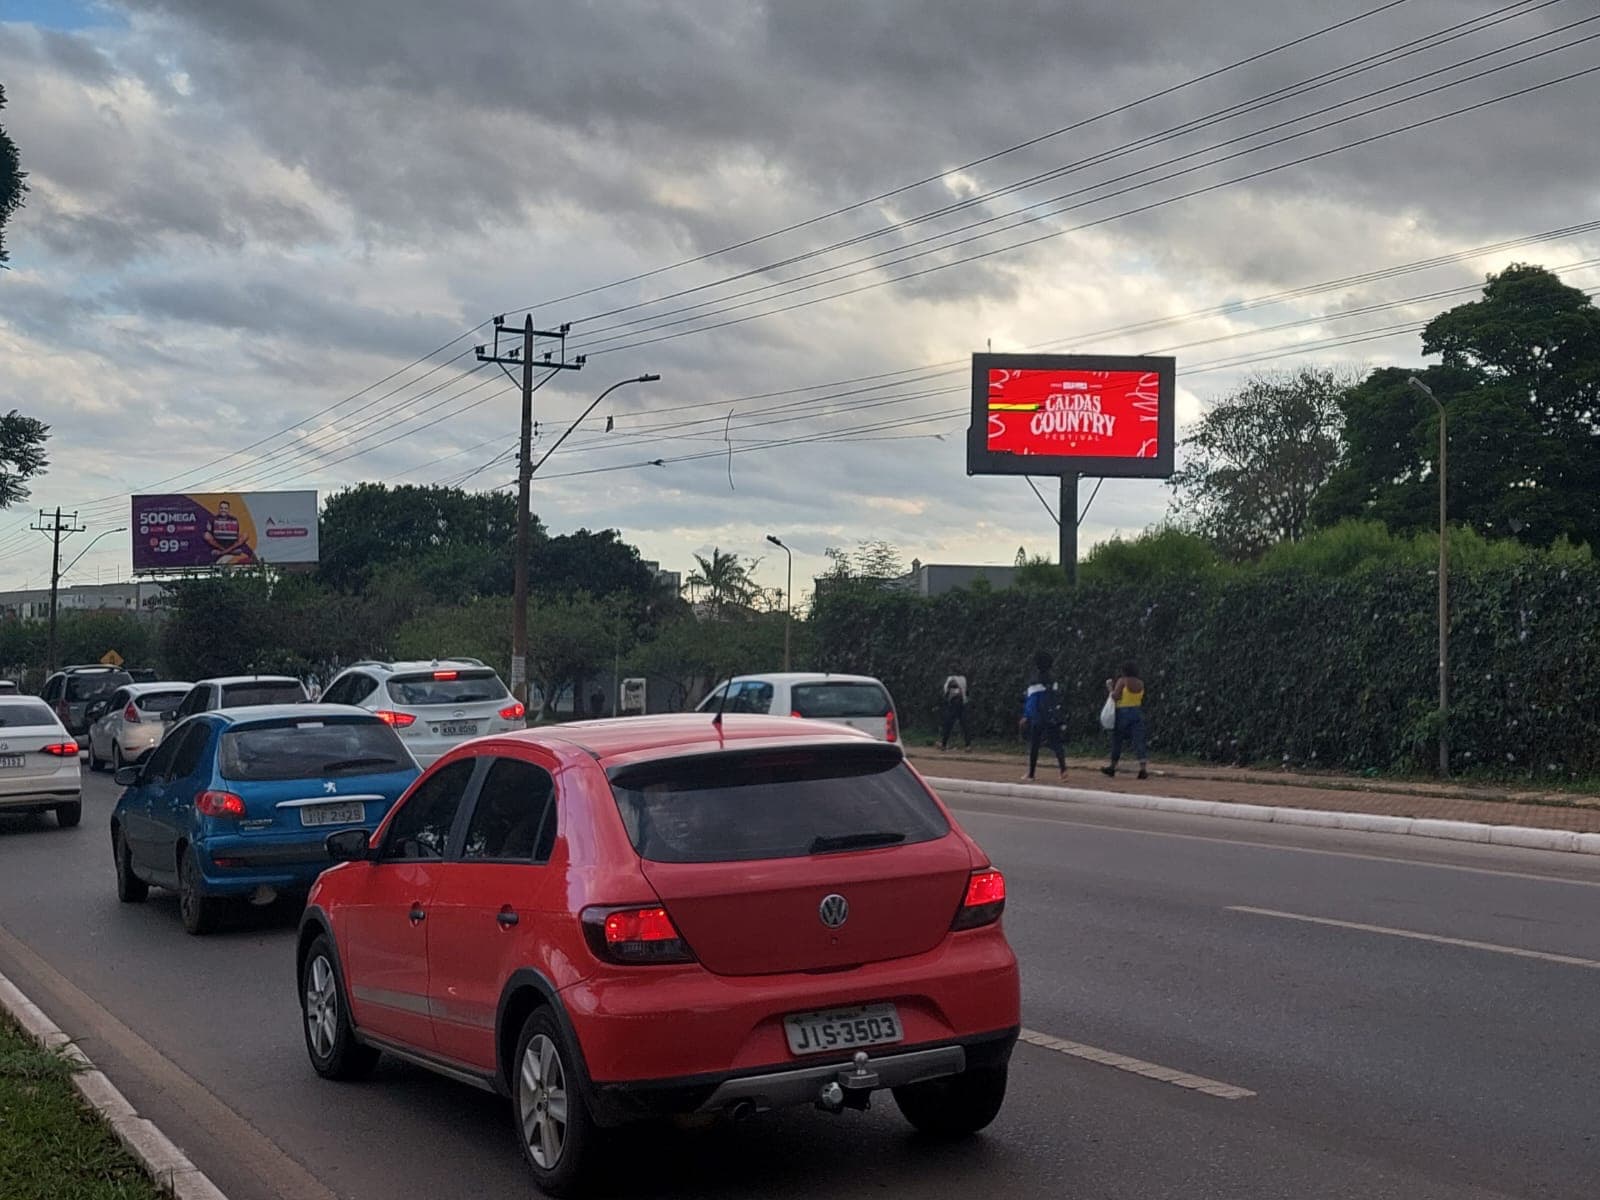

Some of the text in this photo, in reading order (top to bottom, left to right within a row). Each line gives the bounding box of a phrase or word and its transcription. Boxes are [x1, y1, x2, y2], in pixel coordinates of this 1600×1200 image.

[1045, 394, 1101, 413] CALDAS
[1030, 410, 1115, 437] COUNTRY
[140, 512, 197, 525] 500 MEGA
